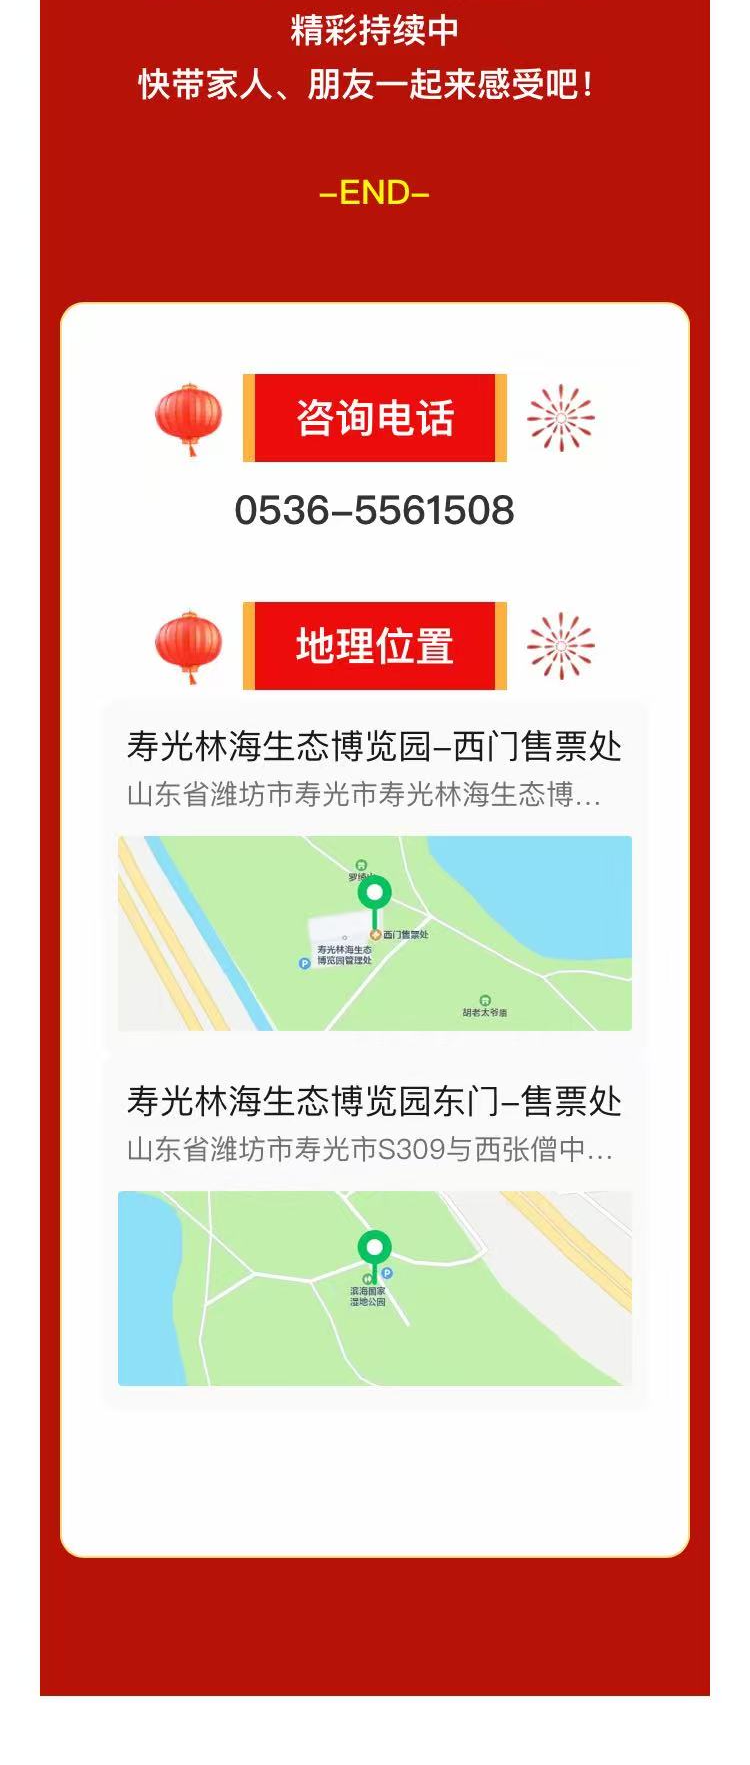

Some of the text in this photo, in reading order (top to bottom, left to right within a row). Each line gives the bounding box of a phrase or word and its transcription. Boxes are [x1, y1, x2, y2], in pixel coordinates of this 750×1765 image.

[290, 13, 459, 47] 精彩持续中
[137, 67, 591, 101] 快带家人、朋友一起来感受吧！
[296, 398, 456, 438] 咨询电话
[234, 494, 515, 526] 0536-5561508
[295, 625, 455, 666] 地理位置
[127, 729, 622, 763] 寿光林海生态博览园-西门售票处
[317, 945, 372, 955] 寿光林海生态
[383, 930, 429, 940] 西门售票处
[317, 956, 372, 966] 博览园管理处
[127, 1084, 622, 1119] 寿光林海生态博览园东门-售票处
[350, 1286, 386, 1296] 滨海国家
[350, 1297, 386, 1307] 湿地公园
